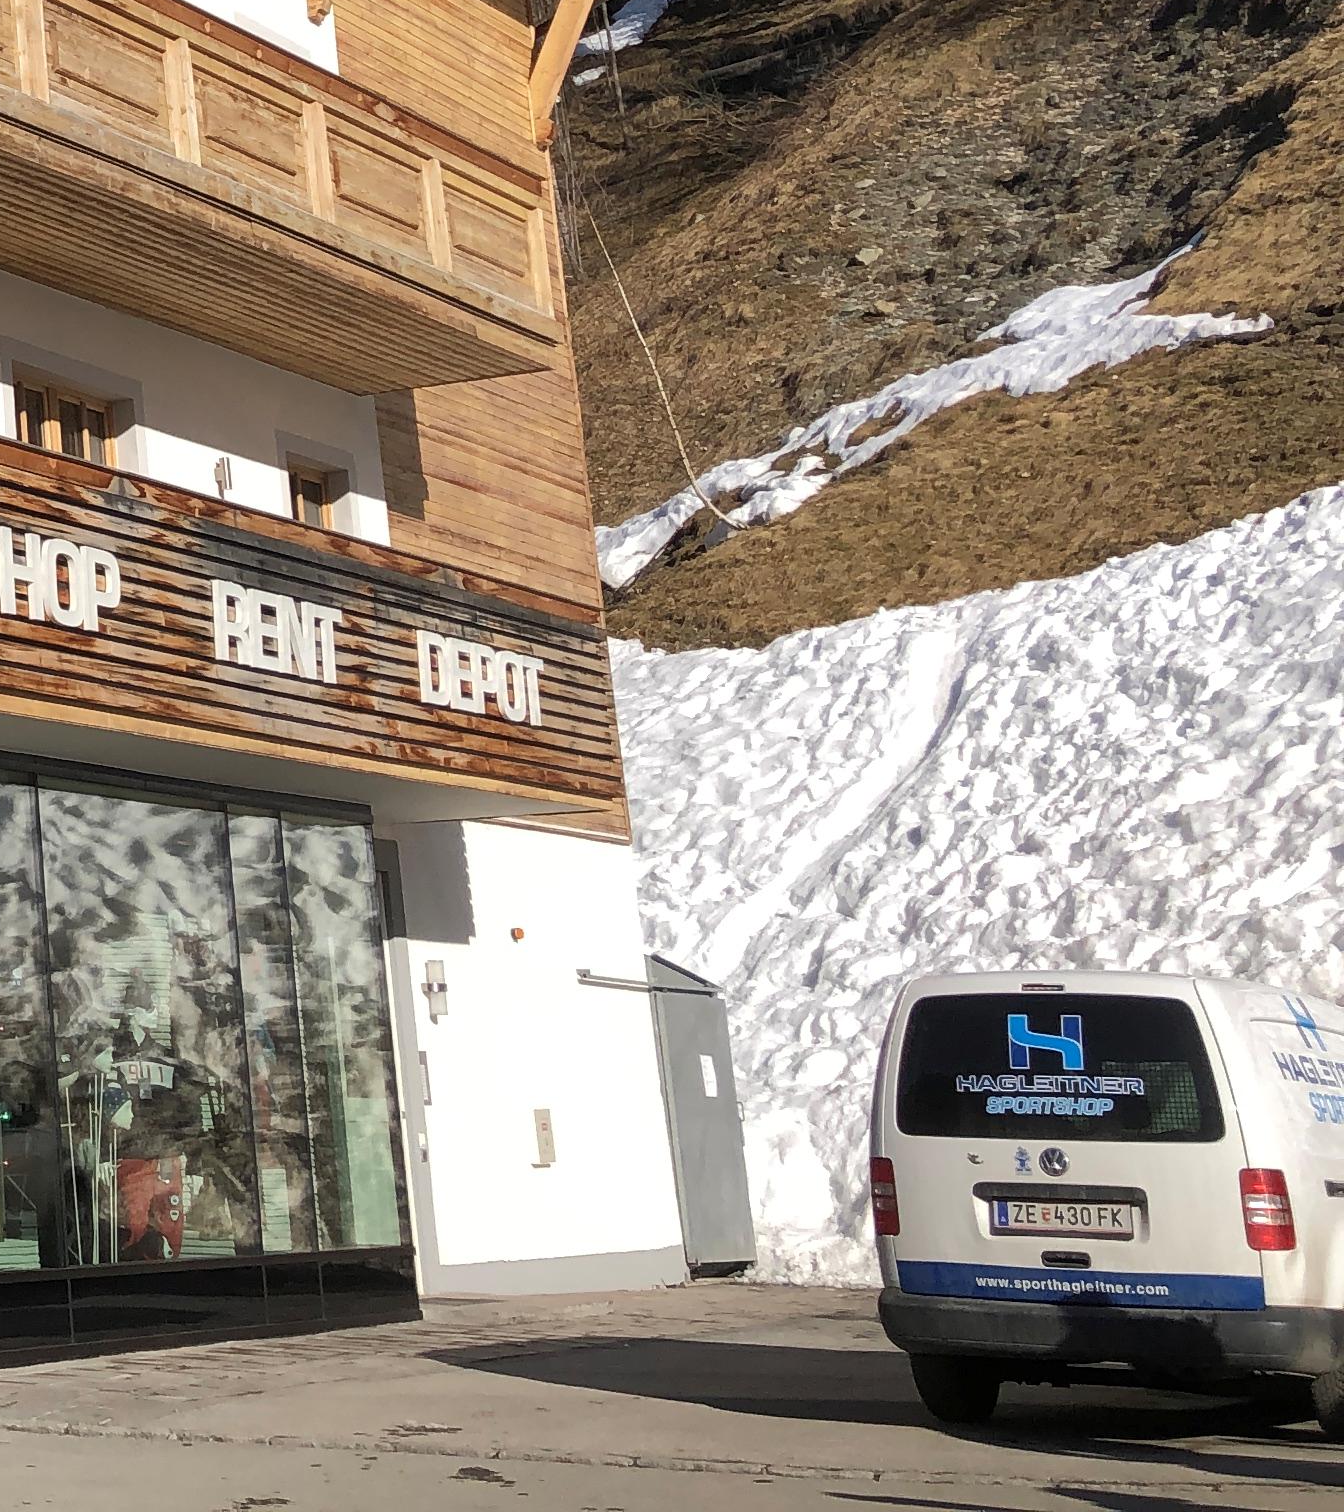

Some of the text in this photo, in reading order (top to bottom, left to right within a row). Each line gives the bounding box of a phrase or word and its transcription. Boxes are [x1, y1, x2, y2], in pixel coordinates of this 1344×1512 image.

[211, 579, 342, 684] RENT
[415, 629, 545, 726] DEPOT
[955, 1074, 1144, 1095] HAGLEITNER
[986, 1096, 1114, 1117] SPORTSHOP
[1013, 1204, 1037, 1224] ZE
[1054, 1206, 1091, 1226] 430
[1098, 1208, 1123, 1227] FK
[975, 1276, 1169, 1295] www.sporthagleitner.com
